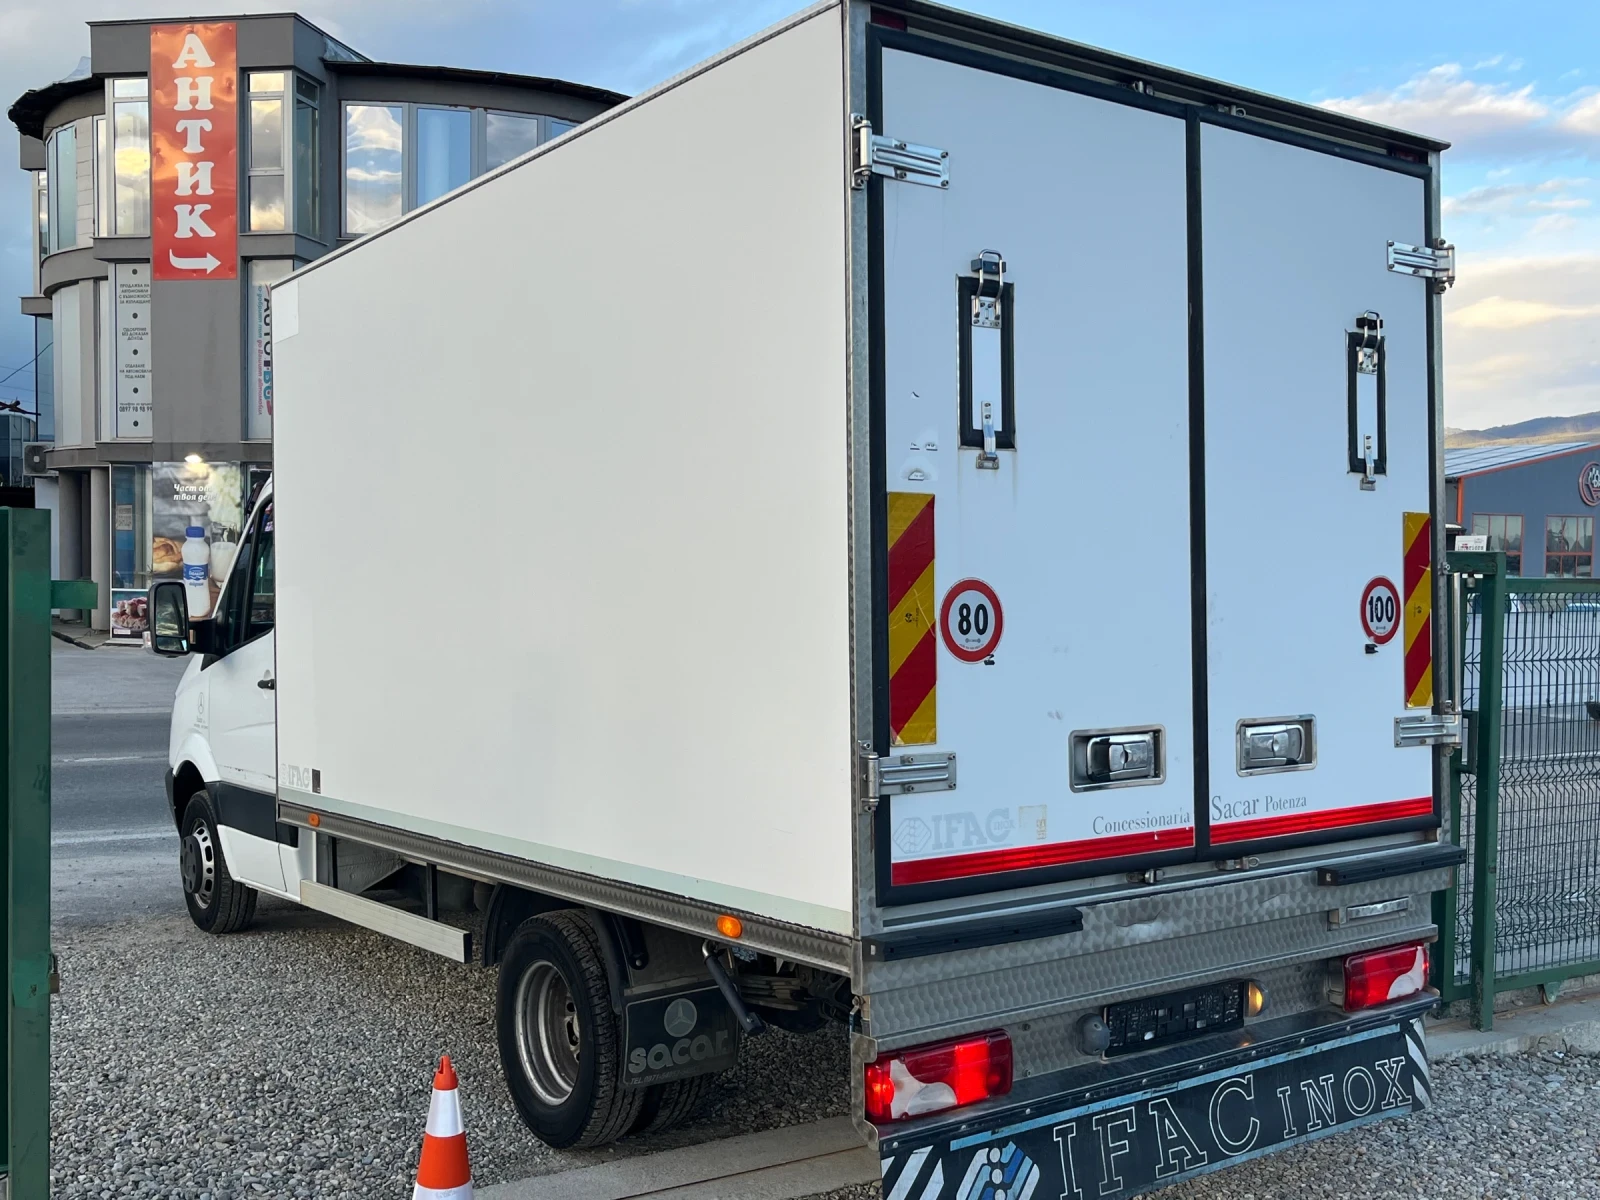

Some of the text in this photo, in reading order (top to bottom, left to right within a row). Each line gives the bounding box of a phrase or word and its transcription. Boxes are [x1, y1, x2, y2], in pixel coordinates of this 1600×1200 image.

[172, 33, 216, 238] АНТИК
[173, 483, 197, 492] Част
[173, 493, 197, 501] твоя
[958, 603, 988, 635] 80
[1368, 596, 1394, 622] 100
[931, 808, 1011, 850] IFAC
[1092, 795, 1307, 835] Concessionaria Sacar Potenza
[628, 1029, 729, 1074] sacar
[1053, 1056, 1412, 1200] IFAC INOX
